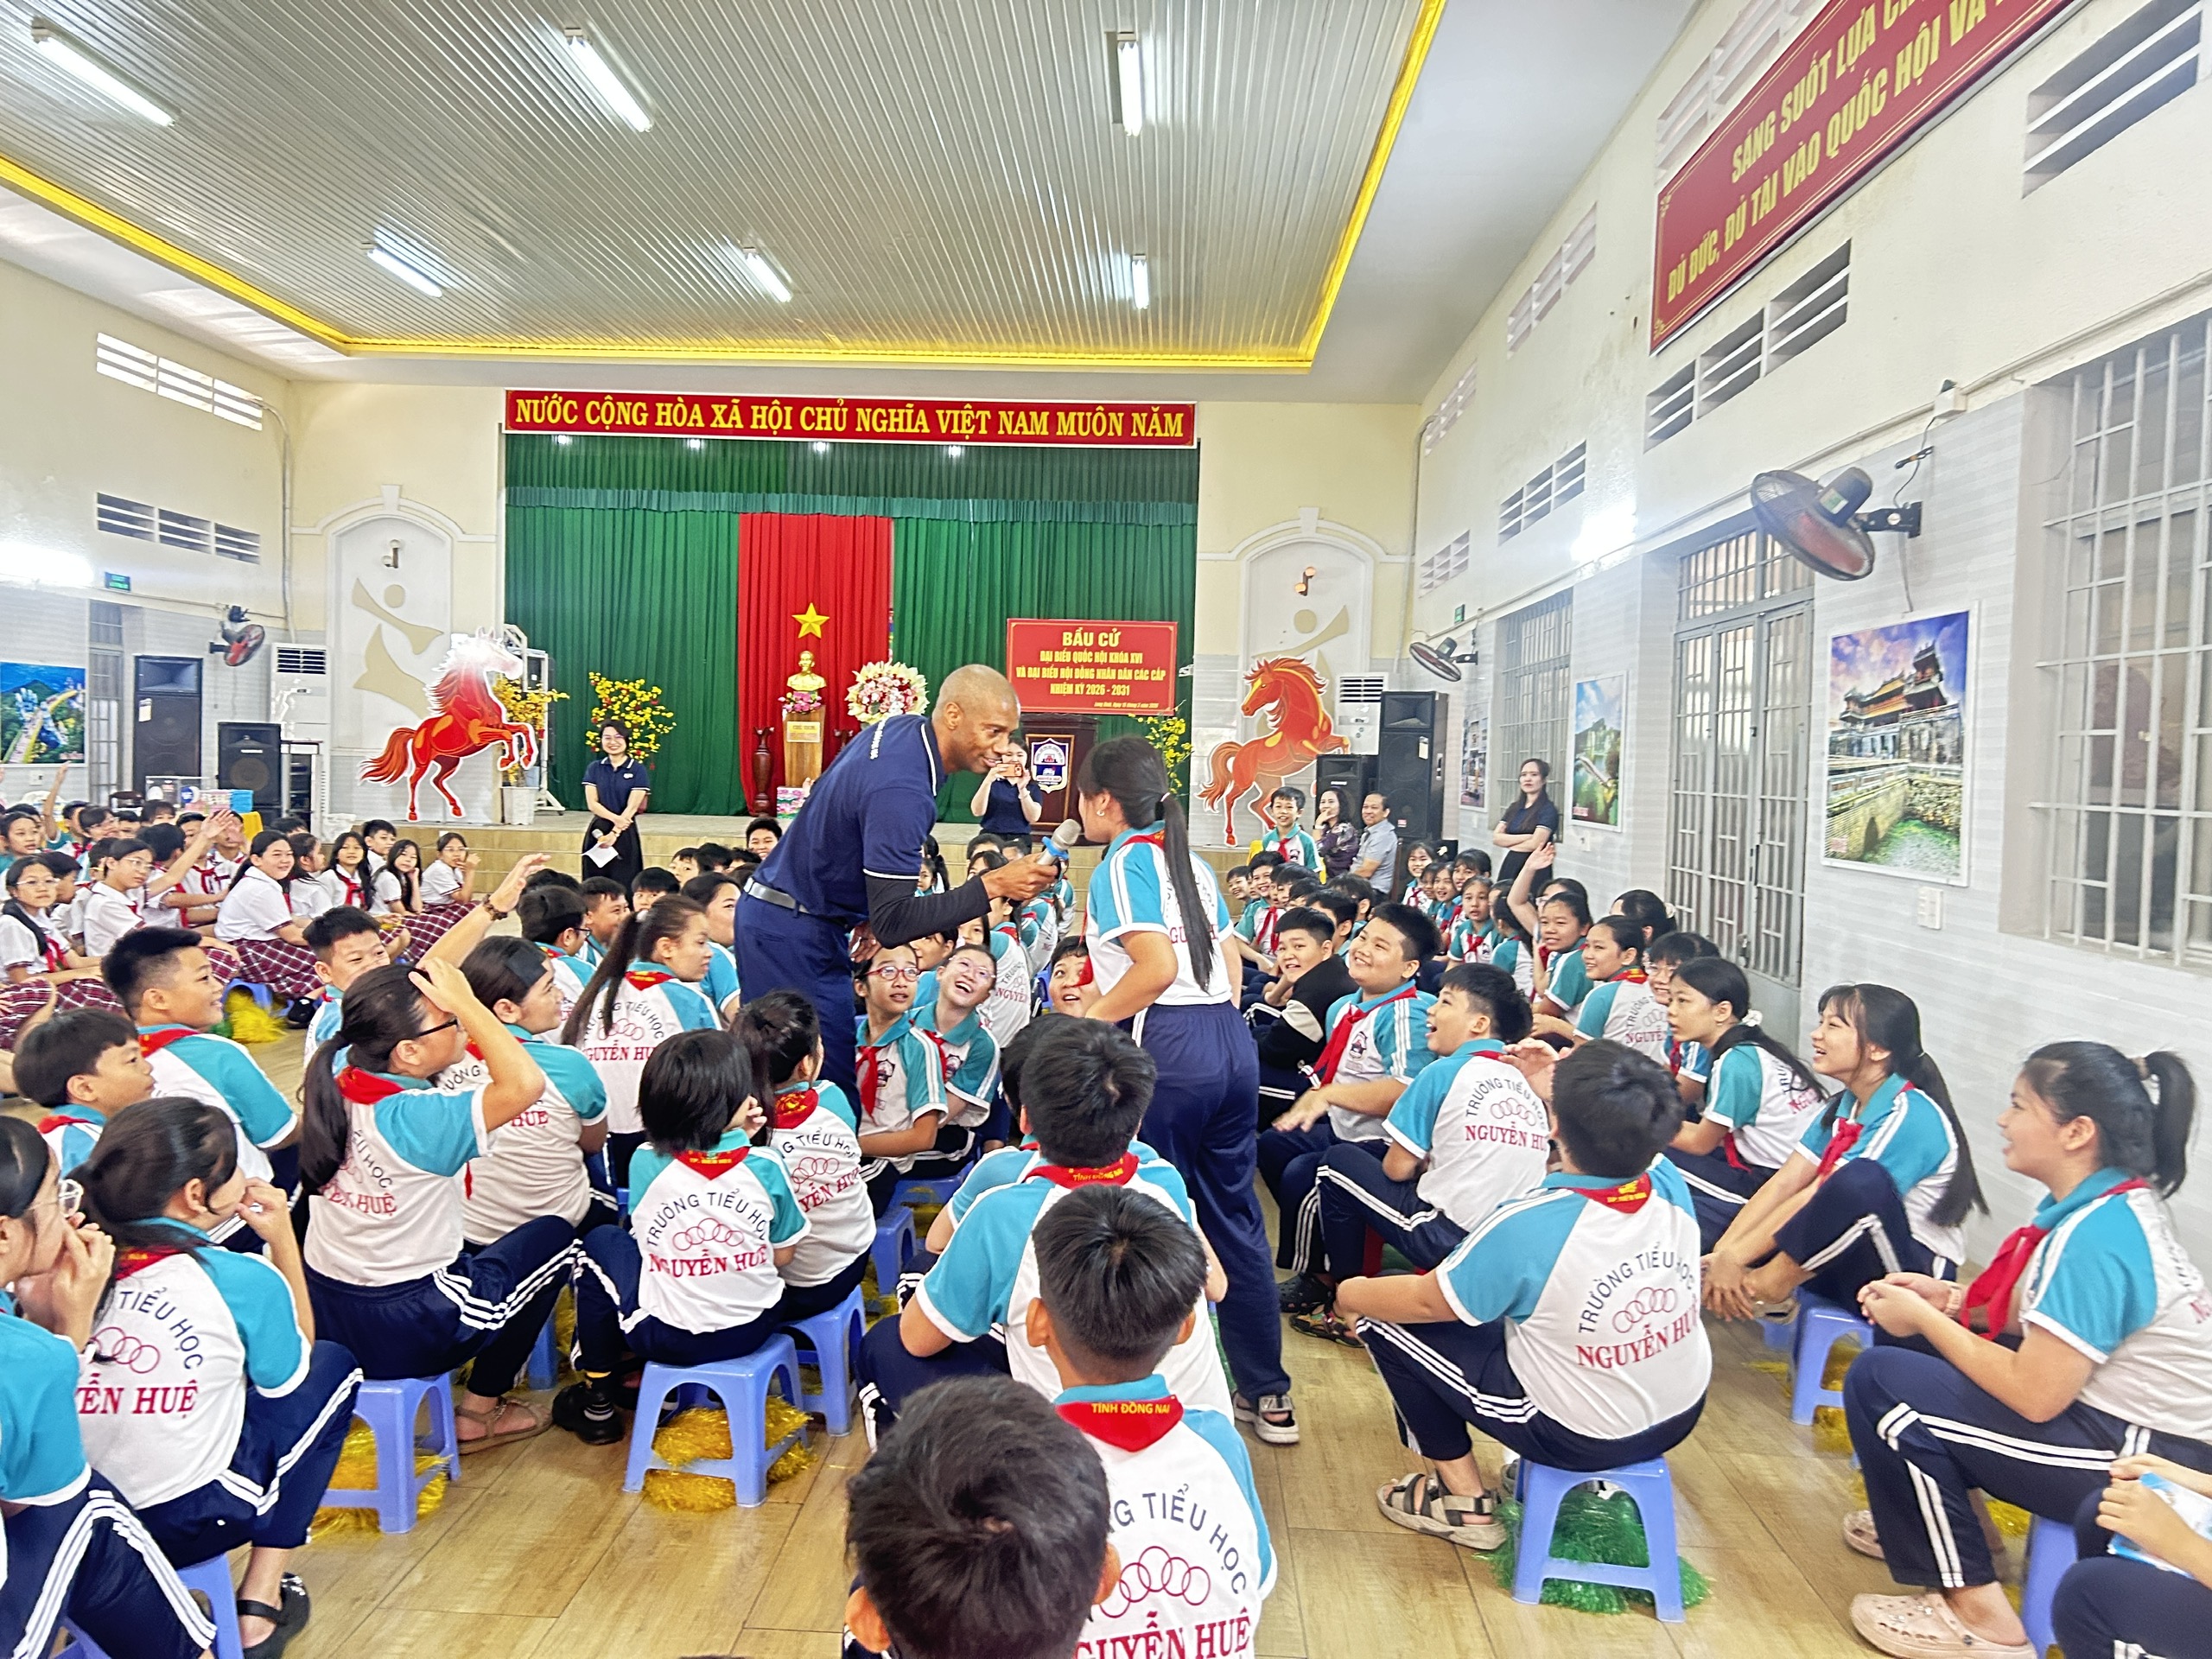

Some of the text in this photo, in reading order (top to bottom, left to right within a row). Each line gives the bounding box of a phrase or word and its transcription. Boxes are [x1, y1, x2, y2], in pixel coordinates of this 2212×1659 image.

[1732, 3, 1876, 183] SÁNG SUỐT LỰA
[1751, 170, 1778, 226] TÀI
[1783, 131, 1821, 198] VÀO
[1826, 68, 1888, 159] QUỐC
[1894, 15, 1942, 97] HỘI
[516, 392, 1184, 440] NƯỚC CỘNG HÒA XÃ HỘI CHỦ NGHĨA VIỆT NAM MUÔN NĂM
[1072, 648, 1093, 664] QUỐC
[1130, 652, 1143, 664] XVI
[1097, 627, 1122, 647] CỬ
[1085, 683, 1105, 696] 2026
[1111, 684, 1130, 696] 2031
[1465, 1077, 1503, 1117] TRƯỜNG
[796, 1126, 832, 1147] TIỂU
[1465, 1121, 1528, 1147] NGUYỄN
[356, 1192, 397, 1217] HUỆ
[646, 1194, 700, 1247] TRƯỜNG
[707, 1188, 749, 1215] TIỂU
[648, 1249, 728, 1278] NGUYỄN
[1578, 1262, 1634, 1334] TRƯỜNG
[1635, 1242, 1675, 1271] TIỂU
[119, 1287, 176, 1320] TIỂU
[169, 1319, 204, 1370] HỌC
[1575, 1323, 1669, 1369] NGUYỄN
[132, 1379, 199, 1419] HUỆ
[1154, 1403, 1170, 1414] NAI
[1142, 1484, 1207, 1531] TIỂU
[1209, 1523, 1247, 1594] HỌC
